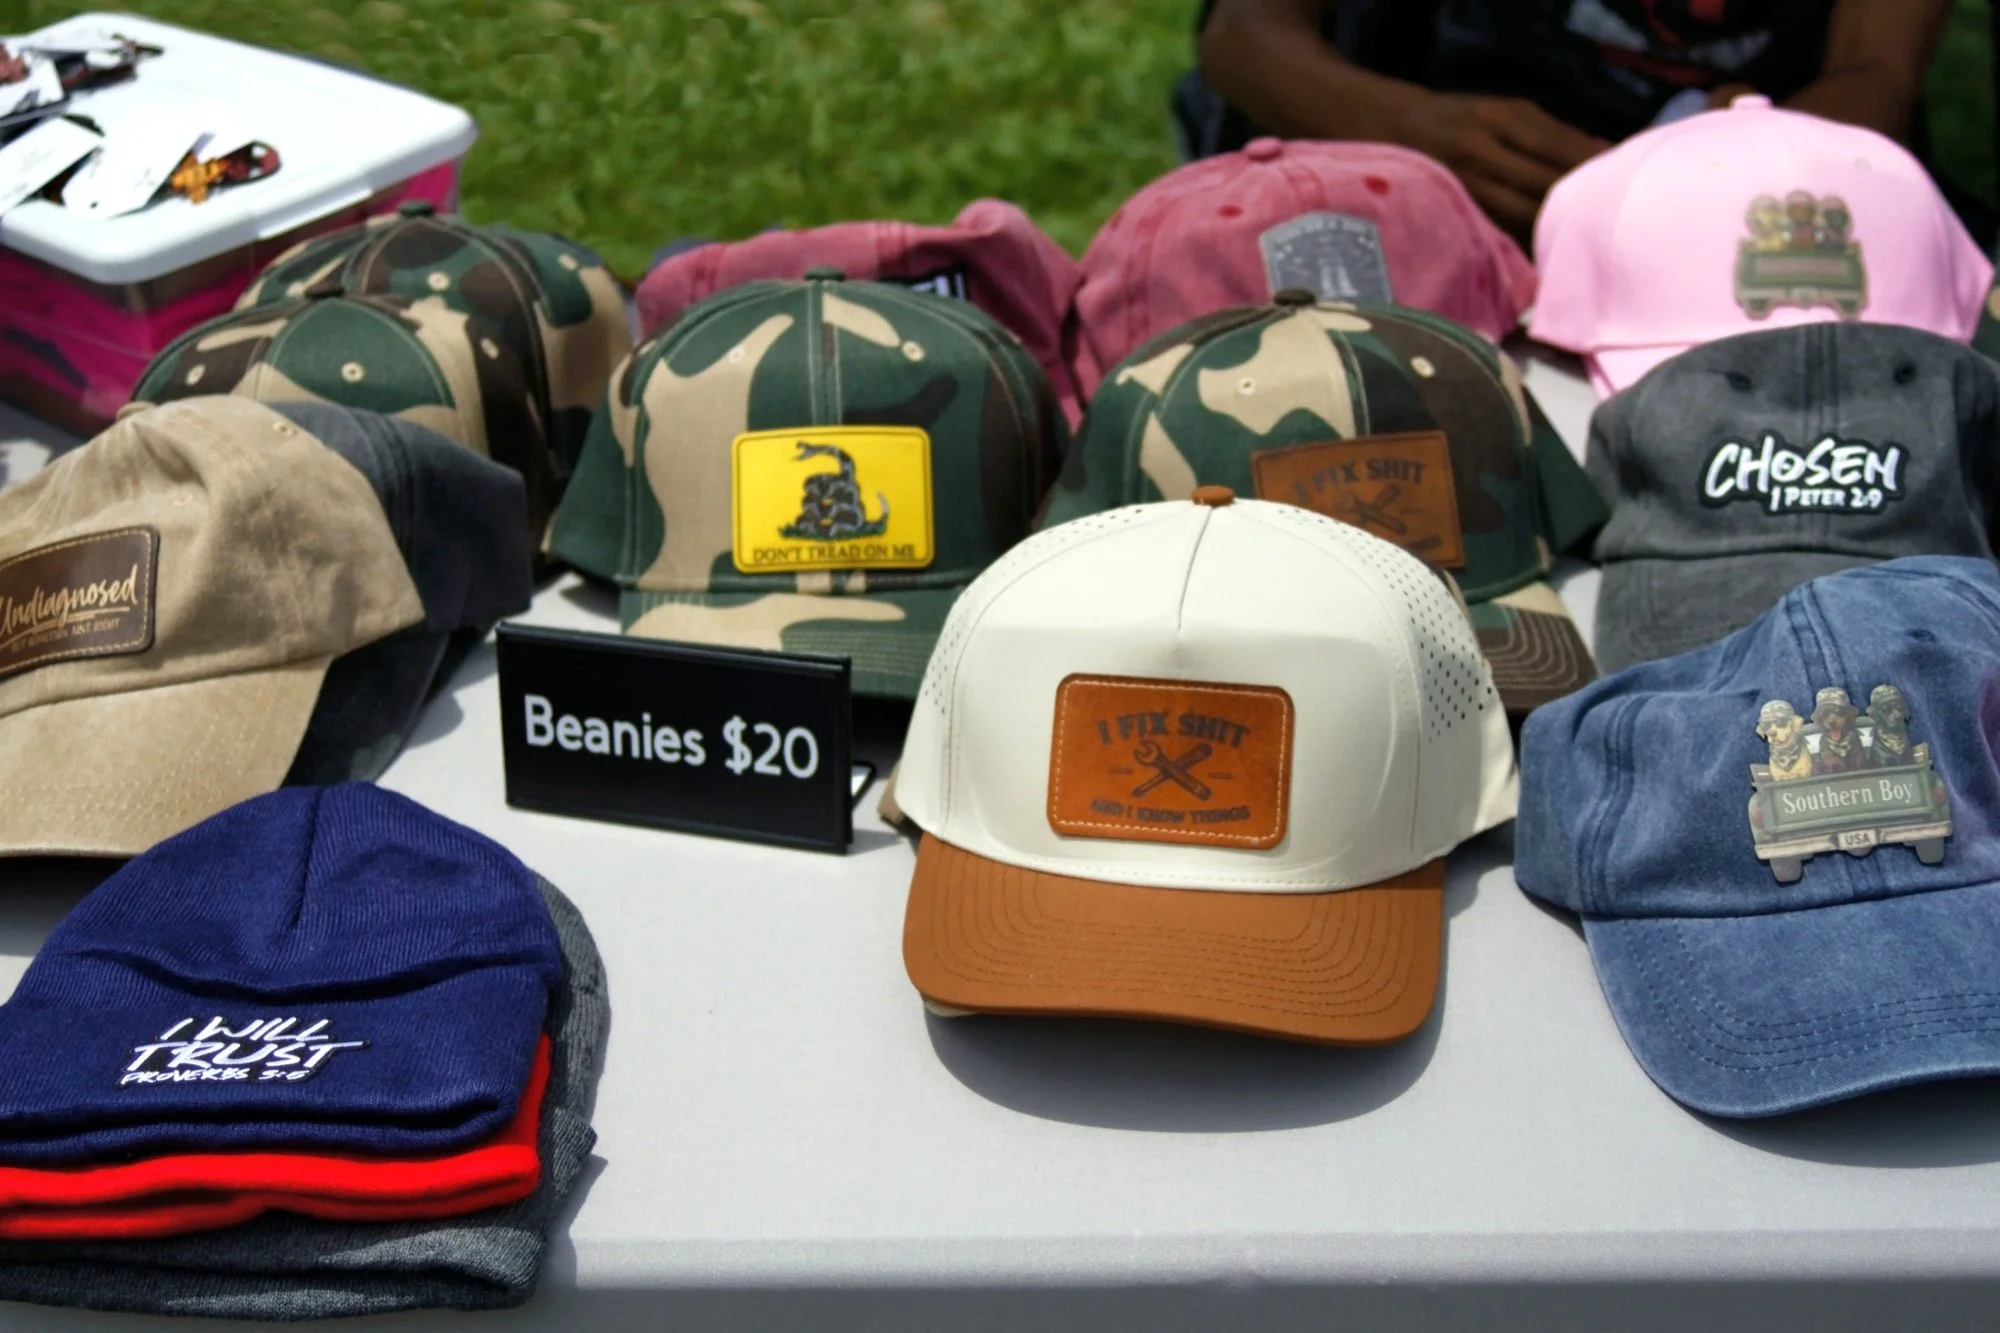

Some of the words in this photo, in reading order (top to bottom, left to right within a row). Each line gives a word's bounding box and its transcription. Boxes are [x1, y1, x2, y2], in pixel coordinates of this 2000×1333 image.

[1312, 461, 1359, 491] FIX
[1366, 458, 1427, 484] SHIT
[1705, 435, 1900, 498] CHOSEN
[1784, 486, 1845, 507] PETER
[753, 547, 801, 563] DON'T
[809, 544, 861, 561] TREAD
[864, 544, 888, 560] ON
[893, 543, 915, 559] ME
[524, 694, 706, 766] Beanies
[723, 715, 819, 779] $20
[1097, 719, 1112, 745] I
[1116, 711, 1169, 740] FIX
[1178, 713, 1250, 748] SHIT
[1782, 785, 1873, 815] Southern
[1879, 779, 1913, 804] Boy
[1844, 832, 1871, 846] USA
[160, 1017, 194, 1041] I
[194, 1016, 329, 1041] WILL
[127, 1040, 364, 1071] TRUST
[120, 1068, 251, 1085] PROVERBS
